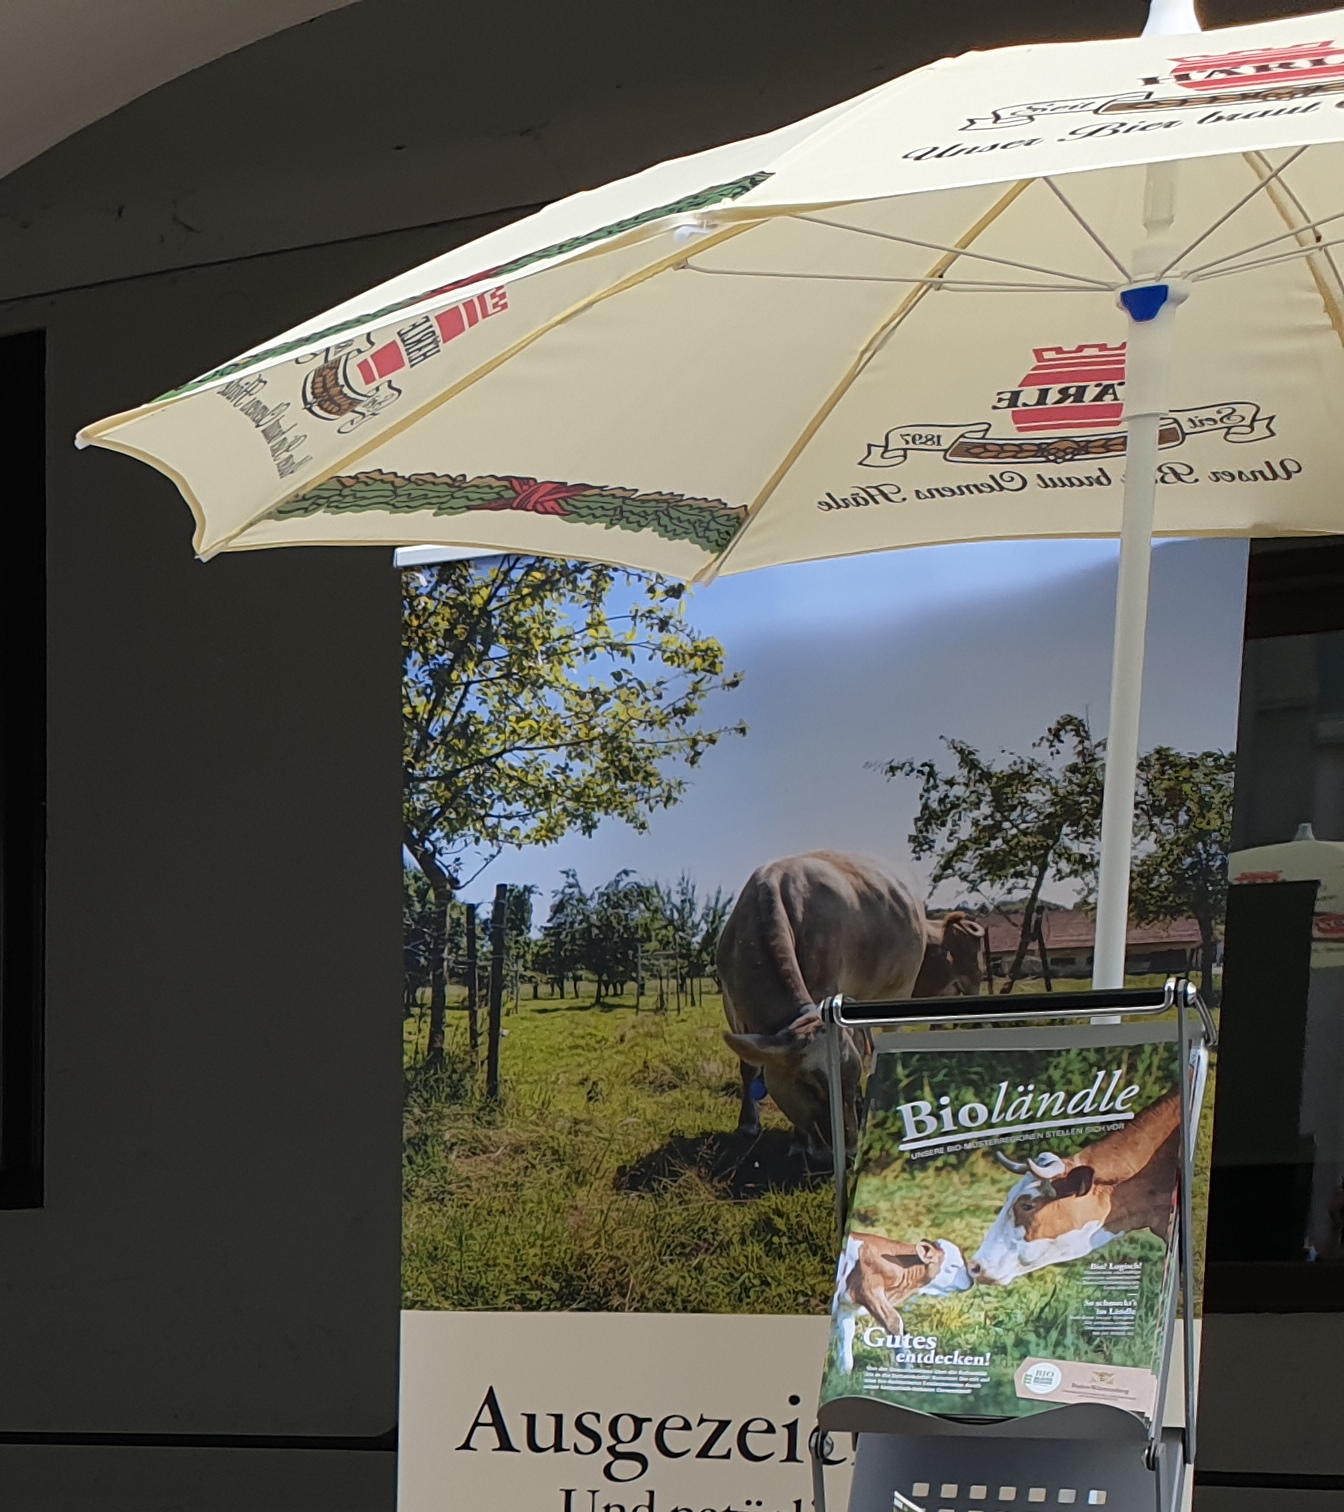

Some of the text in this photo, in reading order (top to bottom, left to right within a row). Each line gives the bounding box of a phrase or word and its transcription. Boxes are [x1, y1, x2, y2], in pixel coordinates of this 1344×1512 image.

[901, 100, 1322, 161] Unser Bier braut
[896, 1070, 1140, 1142] Bioländle
[911, 1148, 945, 1160] UNSERE
[1045, 1127, 1083, 1139] STELLEN
[863, 1327, 937, 1349] Gutes
[896, 1350, 991, 1366] entdecken!
[455, 1385, 858, 1482] Ausgezeic
